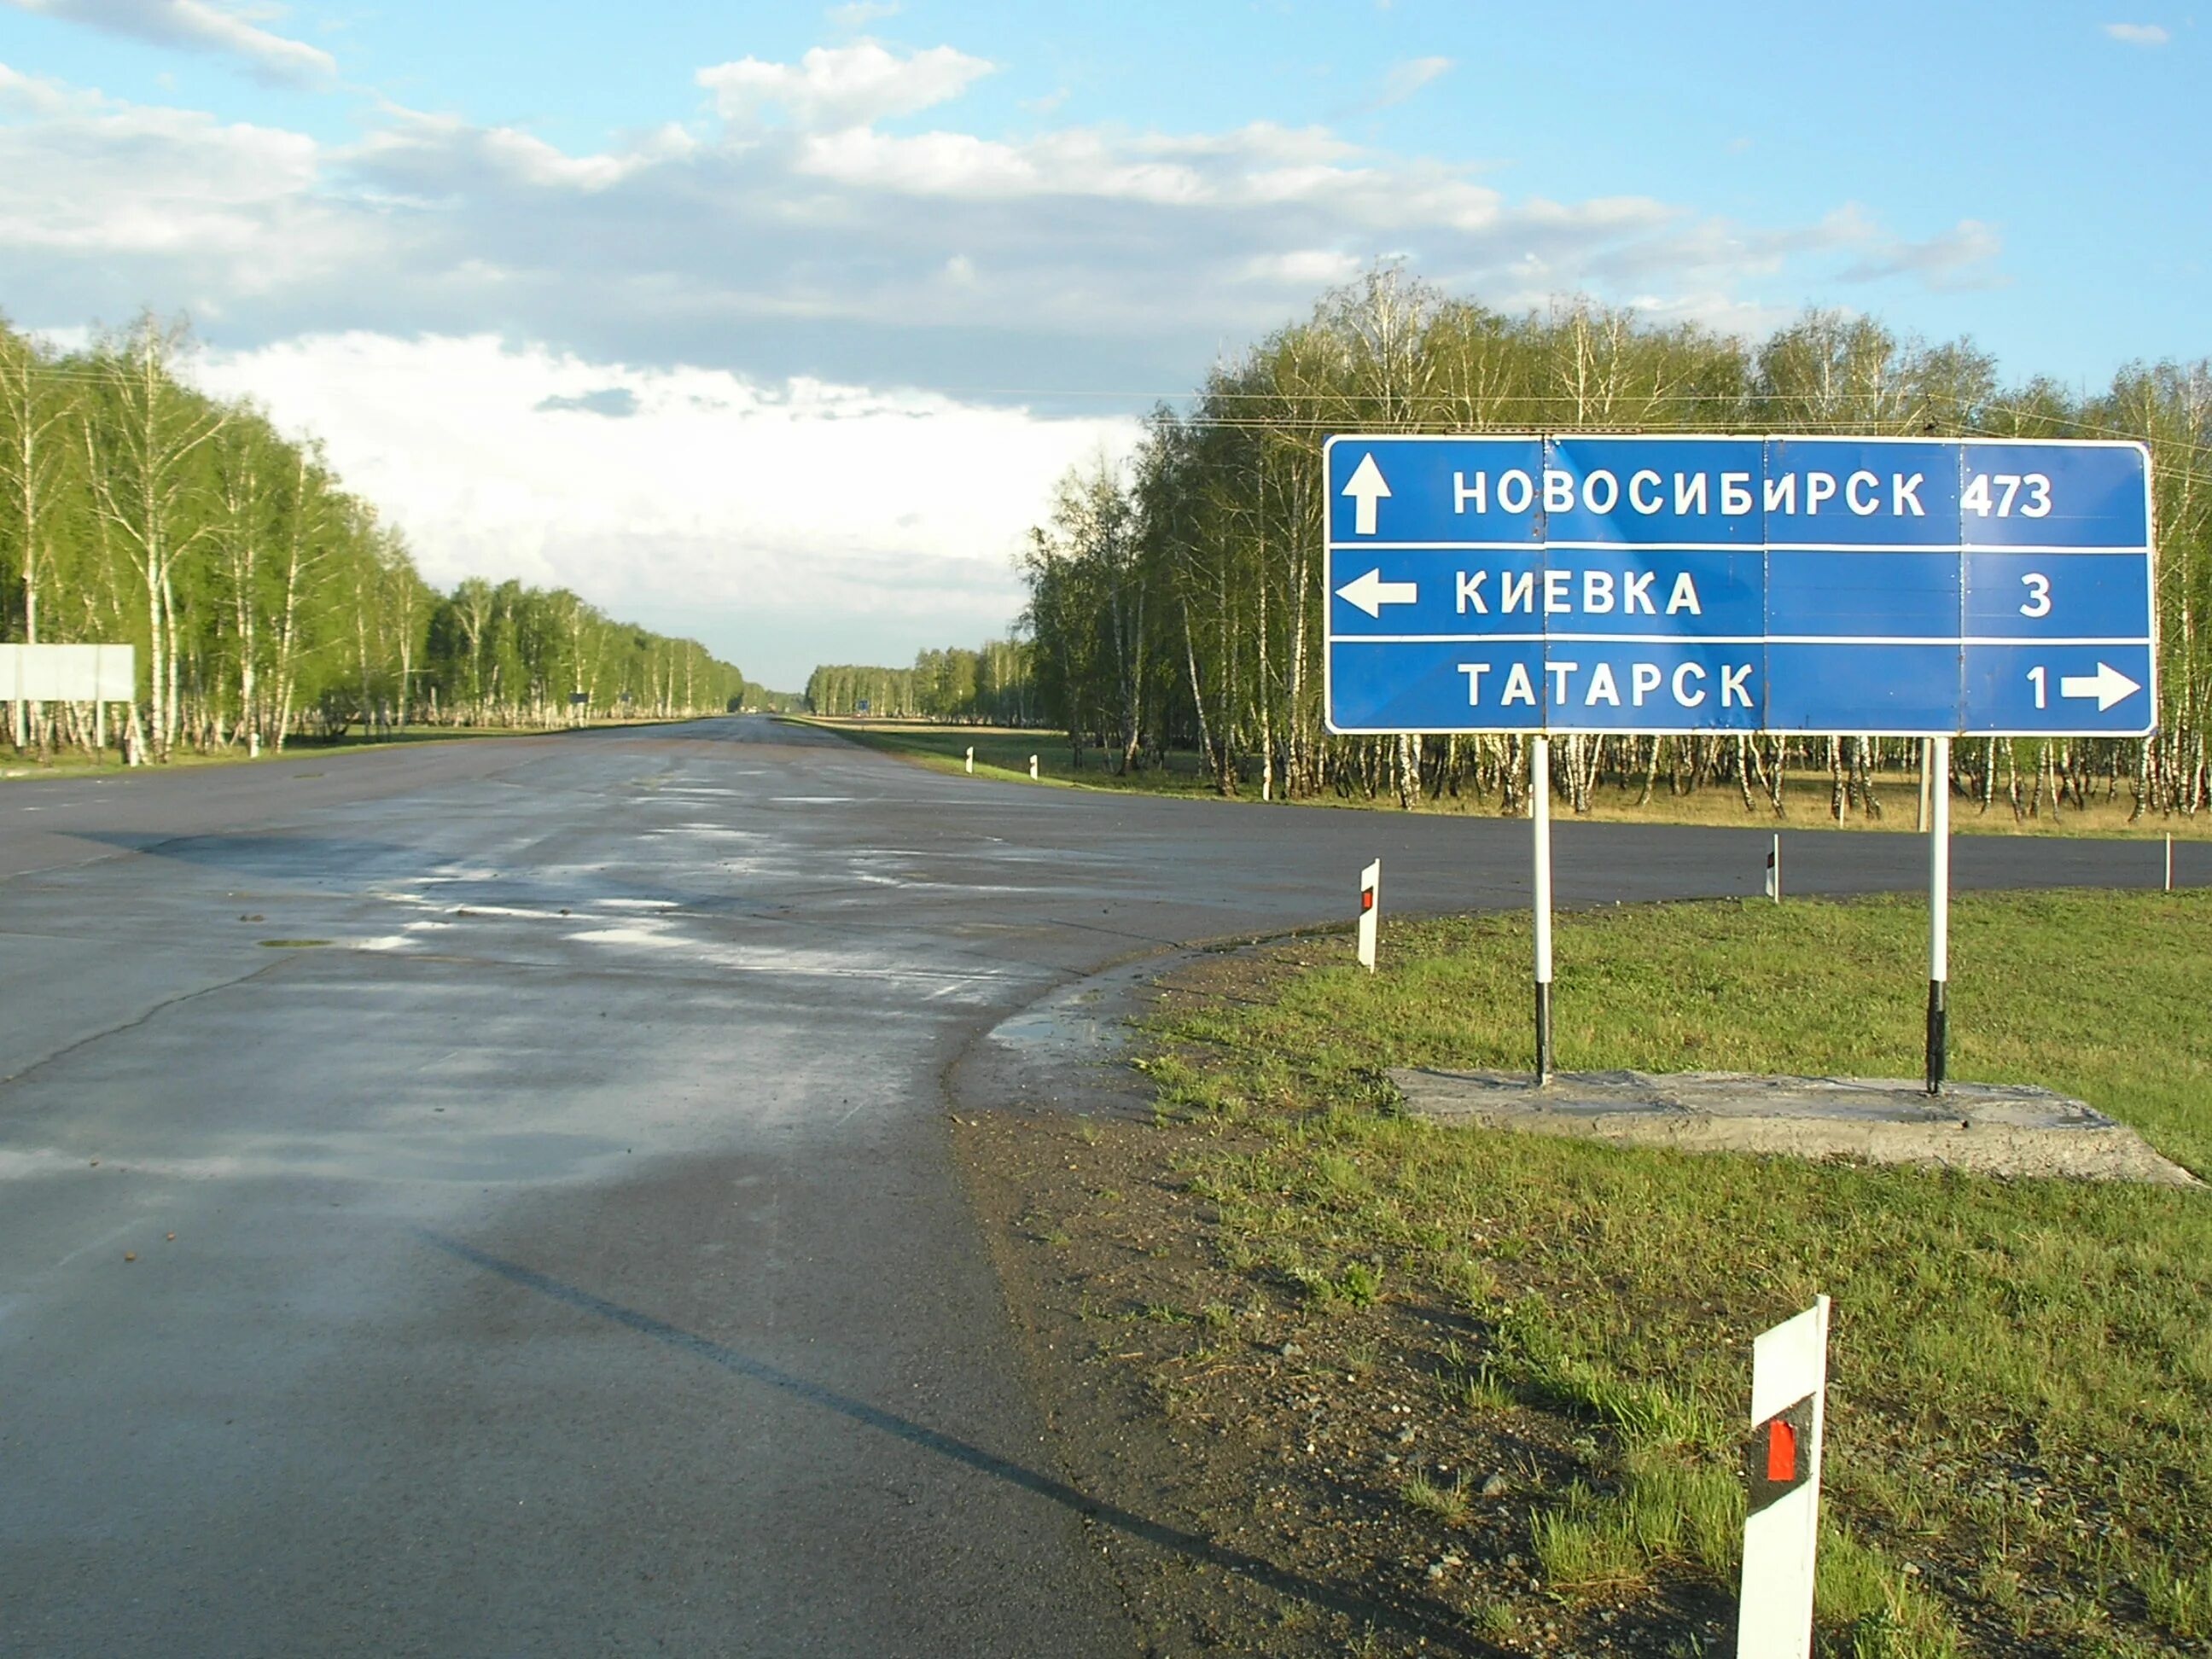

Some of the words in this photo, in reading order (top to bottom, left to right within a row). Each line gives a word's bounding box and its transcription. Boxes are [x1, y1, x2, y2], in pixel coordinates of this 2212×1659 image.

[1452, 469, 1927, 516] НОВОСИБИРСК
[1959, 472, 2053, 518] 473
[1454, 569, 1703, 616] КИЕВКА
[2019, 573, 2052, 618] 3
[1457, 661, 1756, 708] ТАТАРСК
[2026, 666, 2045, 708] 1
